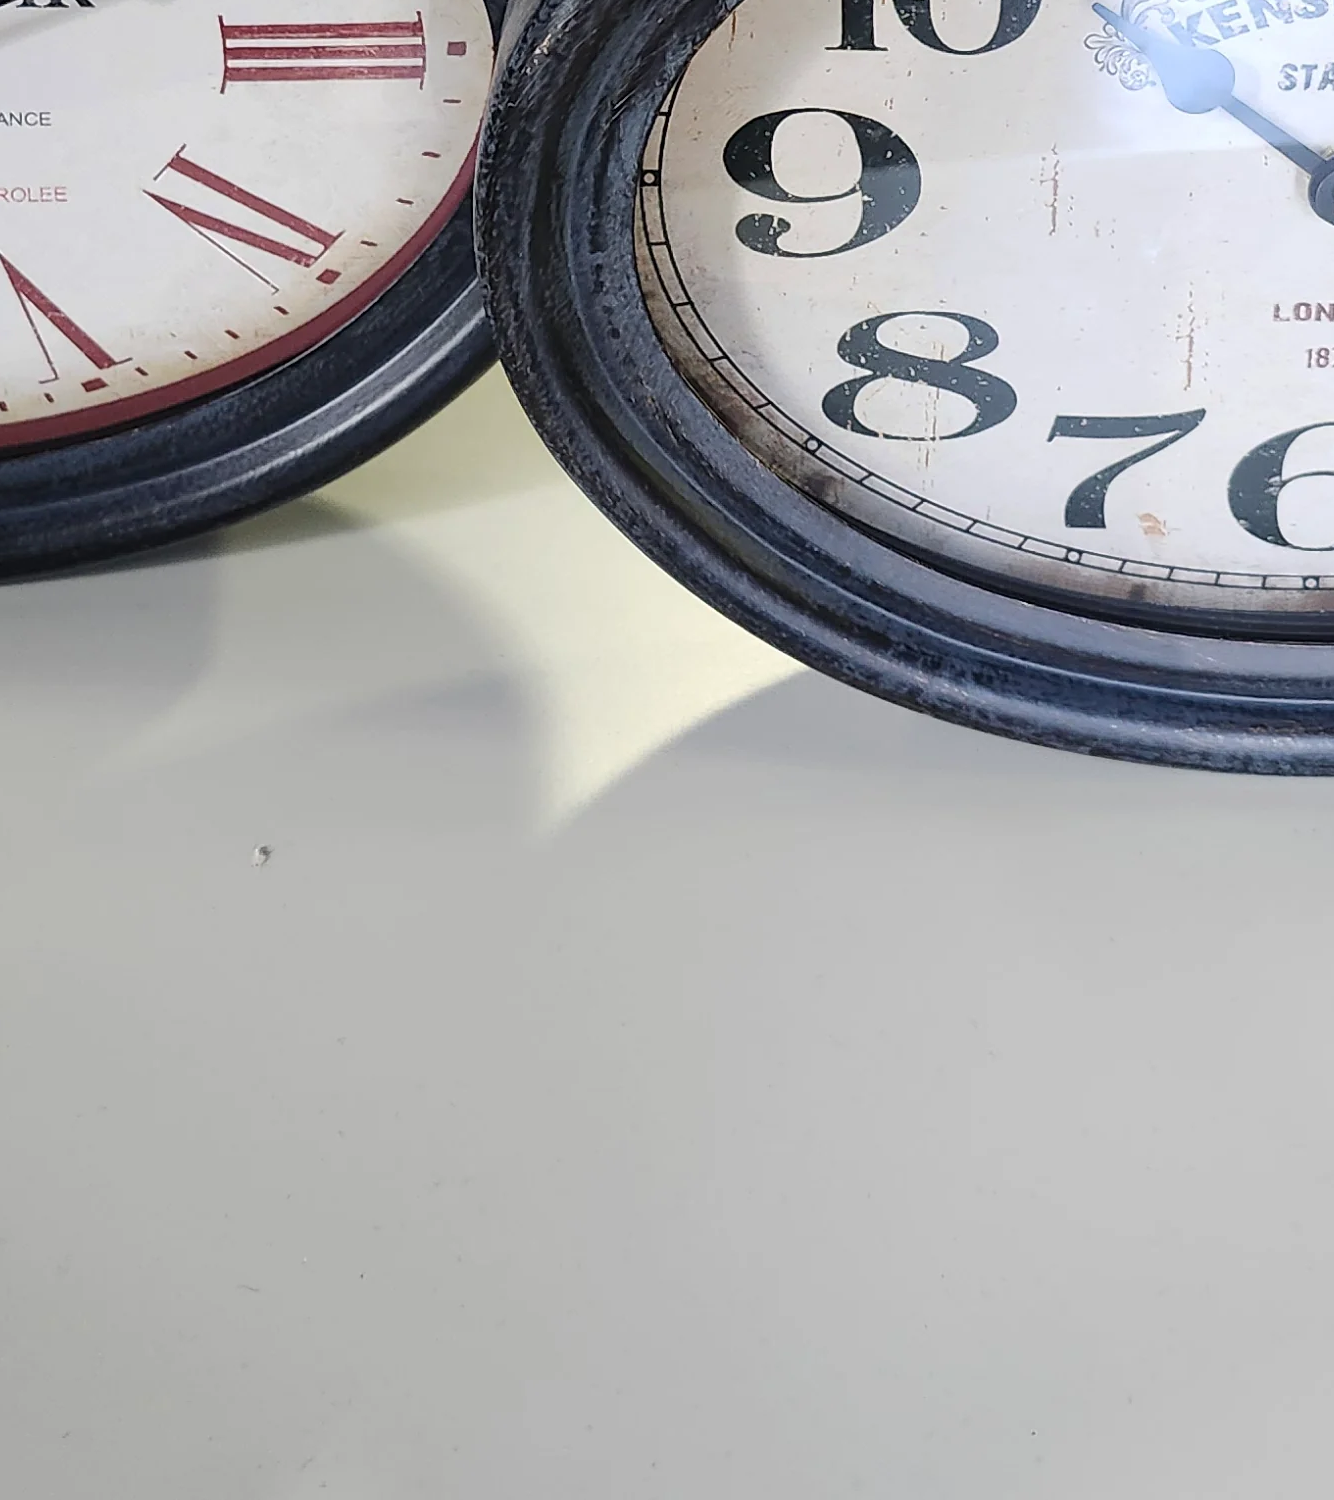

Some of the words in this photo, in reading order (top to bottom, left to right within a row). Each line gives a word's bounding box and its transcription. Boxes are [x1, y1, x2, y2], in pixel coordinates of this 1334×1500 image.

[723, 108, 922, 258] 9
[821, 311, 1018, 440] 8
[1047, 408, 1207, 530] 7
